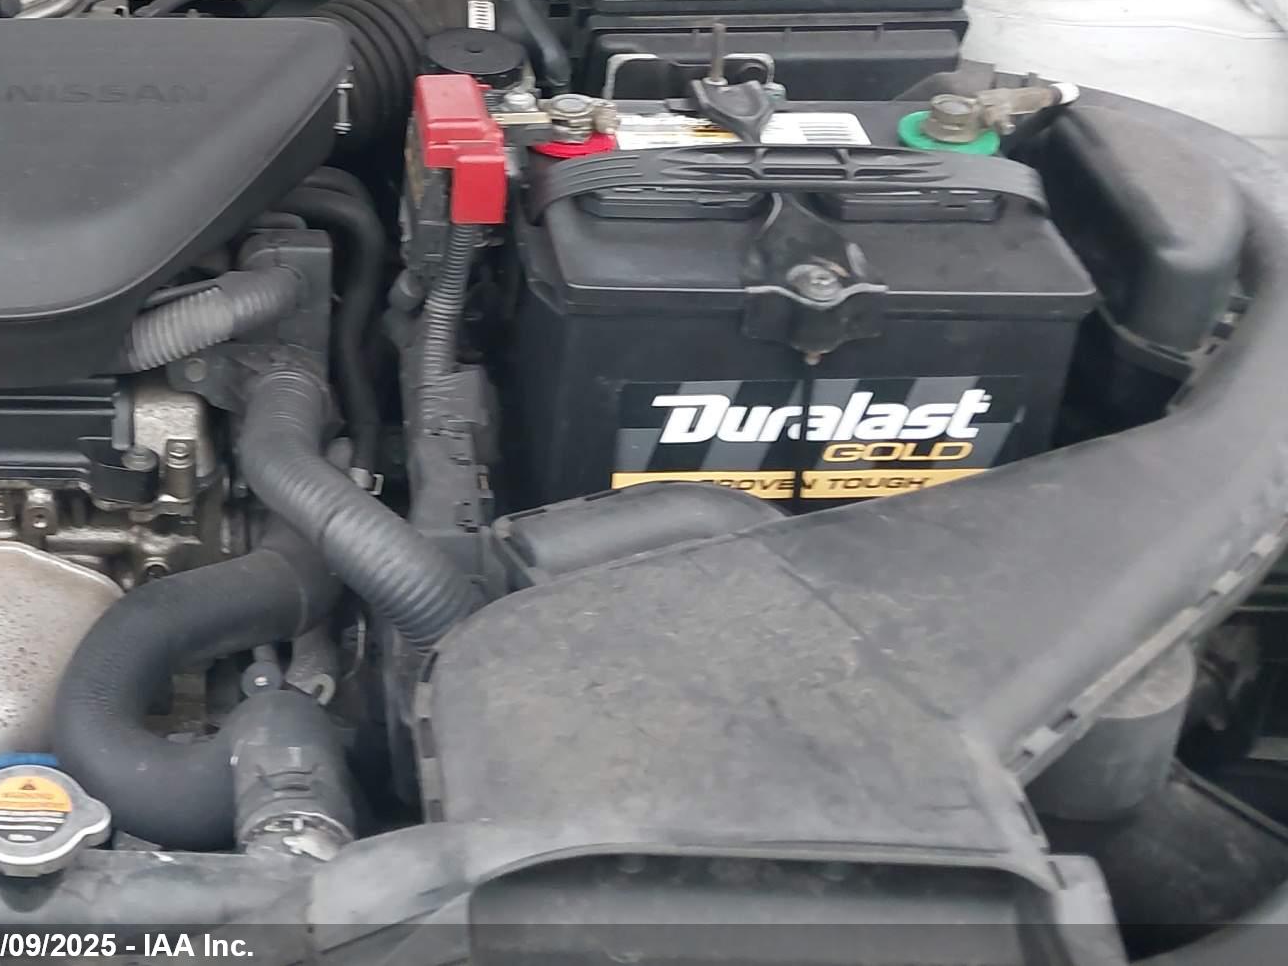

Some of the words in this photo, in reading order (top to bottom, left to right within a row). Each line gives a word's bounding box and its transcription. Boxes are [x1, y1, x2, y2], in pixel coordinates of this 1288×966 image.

[6, 84, 208, 103] NISSAN
[651, 389, 993, 444] Duralast
[822, 442, 974, 462] GOLD
[700, 478, 818, 490] ROVEN
[828, 477, 931, 490] TOUGH
